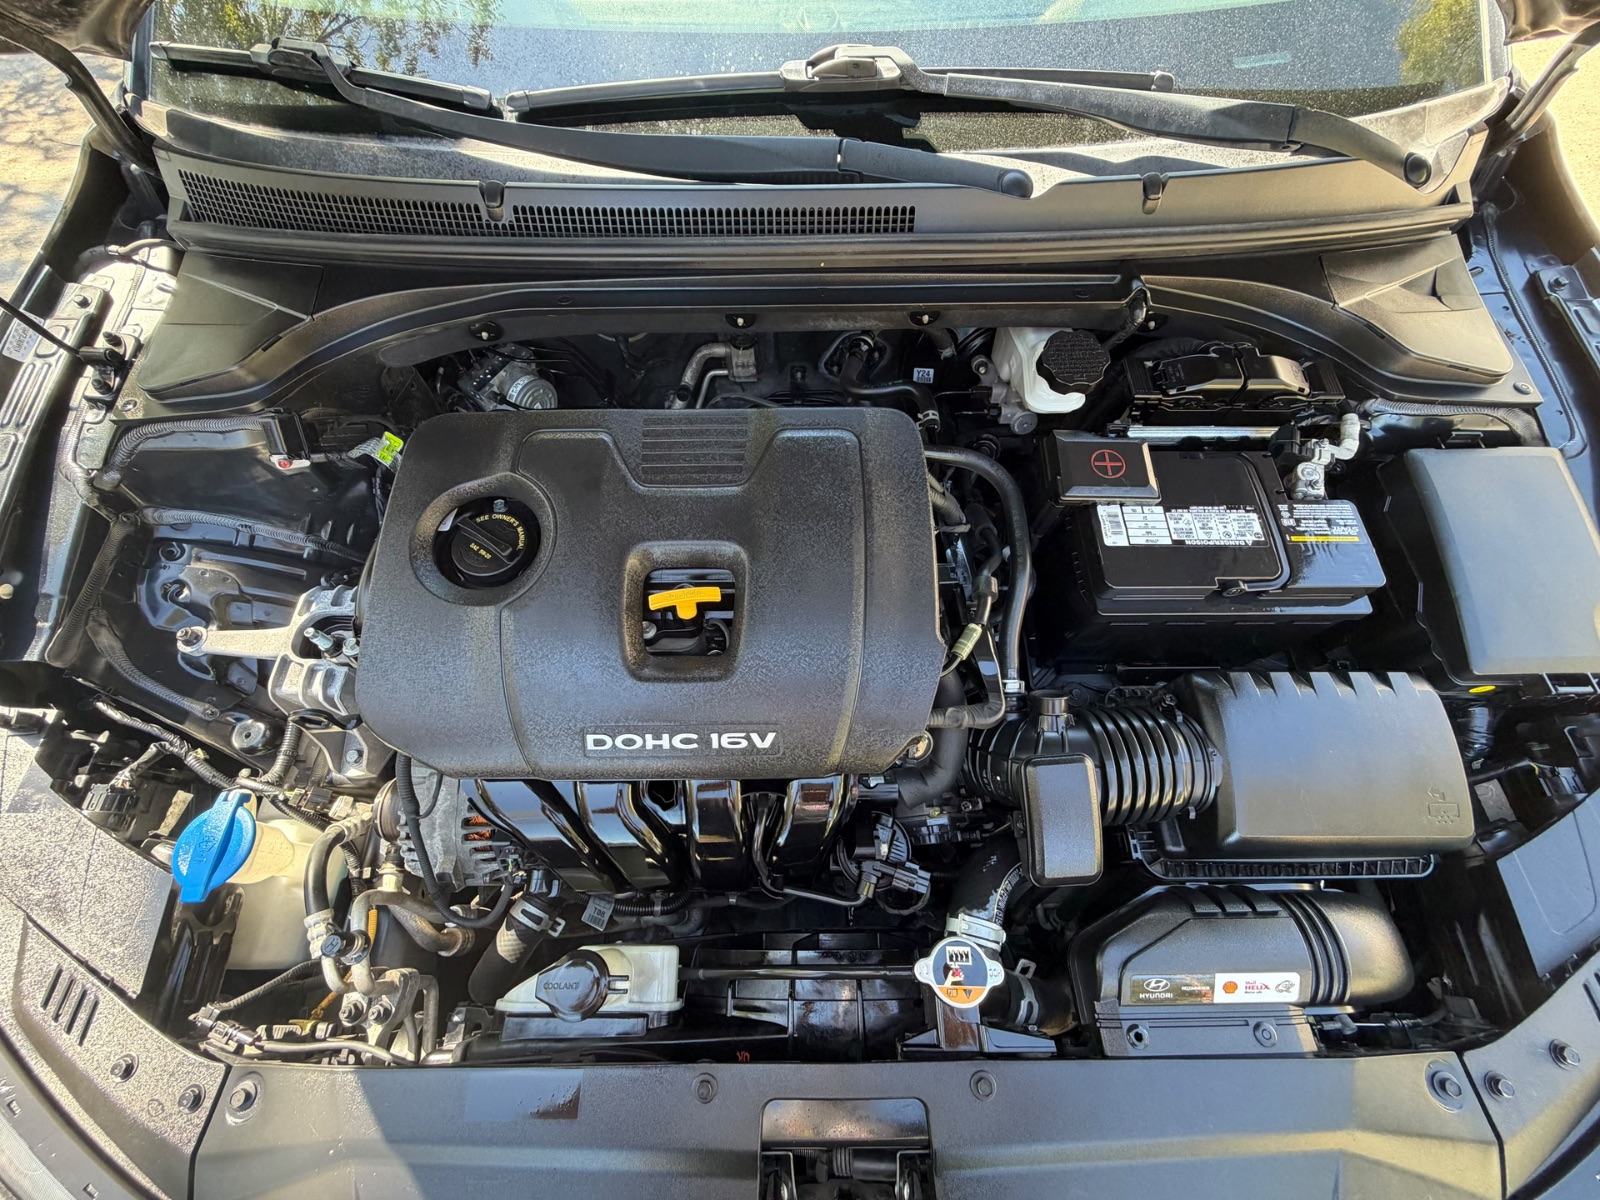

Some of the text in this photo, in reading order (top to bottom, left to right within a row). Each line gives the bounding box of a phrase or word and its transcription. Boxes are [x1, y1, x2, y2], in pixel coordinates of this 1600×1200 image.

[916, 369, 931, 377] Y24
[475, 513, 526, 551] SEE OWNER'S MANUAL
[680, 589, 705, 598] ENGINE
[586, 732, 776, 750] DOHC 16V
[593, 906, 606, 918] T08
[543, 981, 580, 990] COOLANT
[1244, 983, 1271, 991] HELIX
